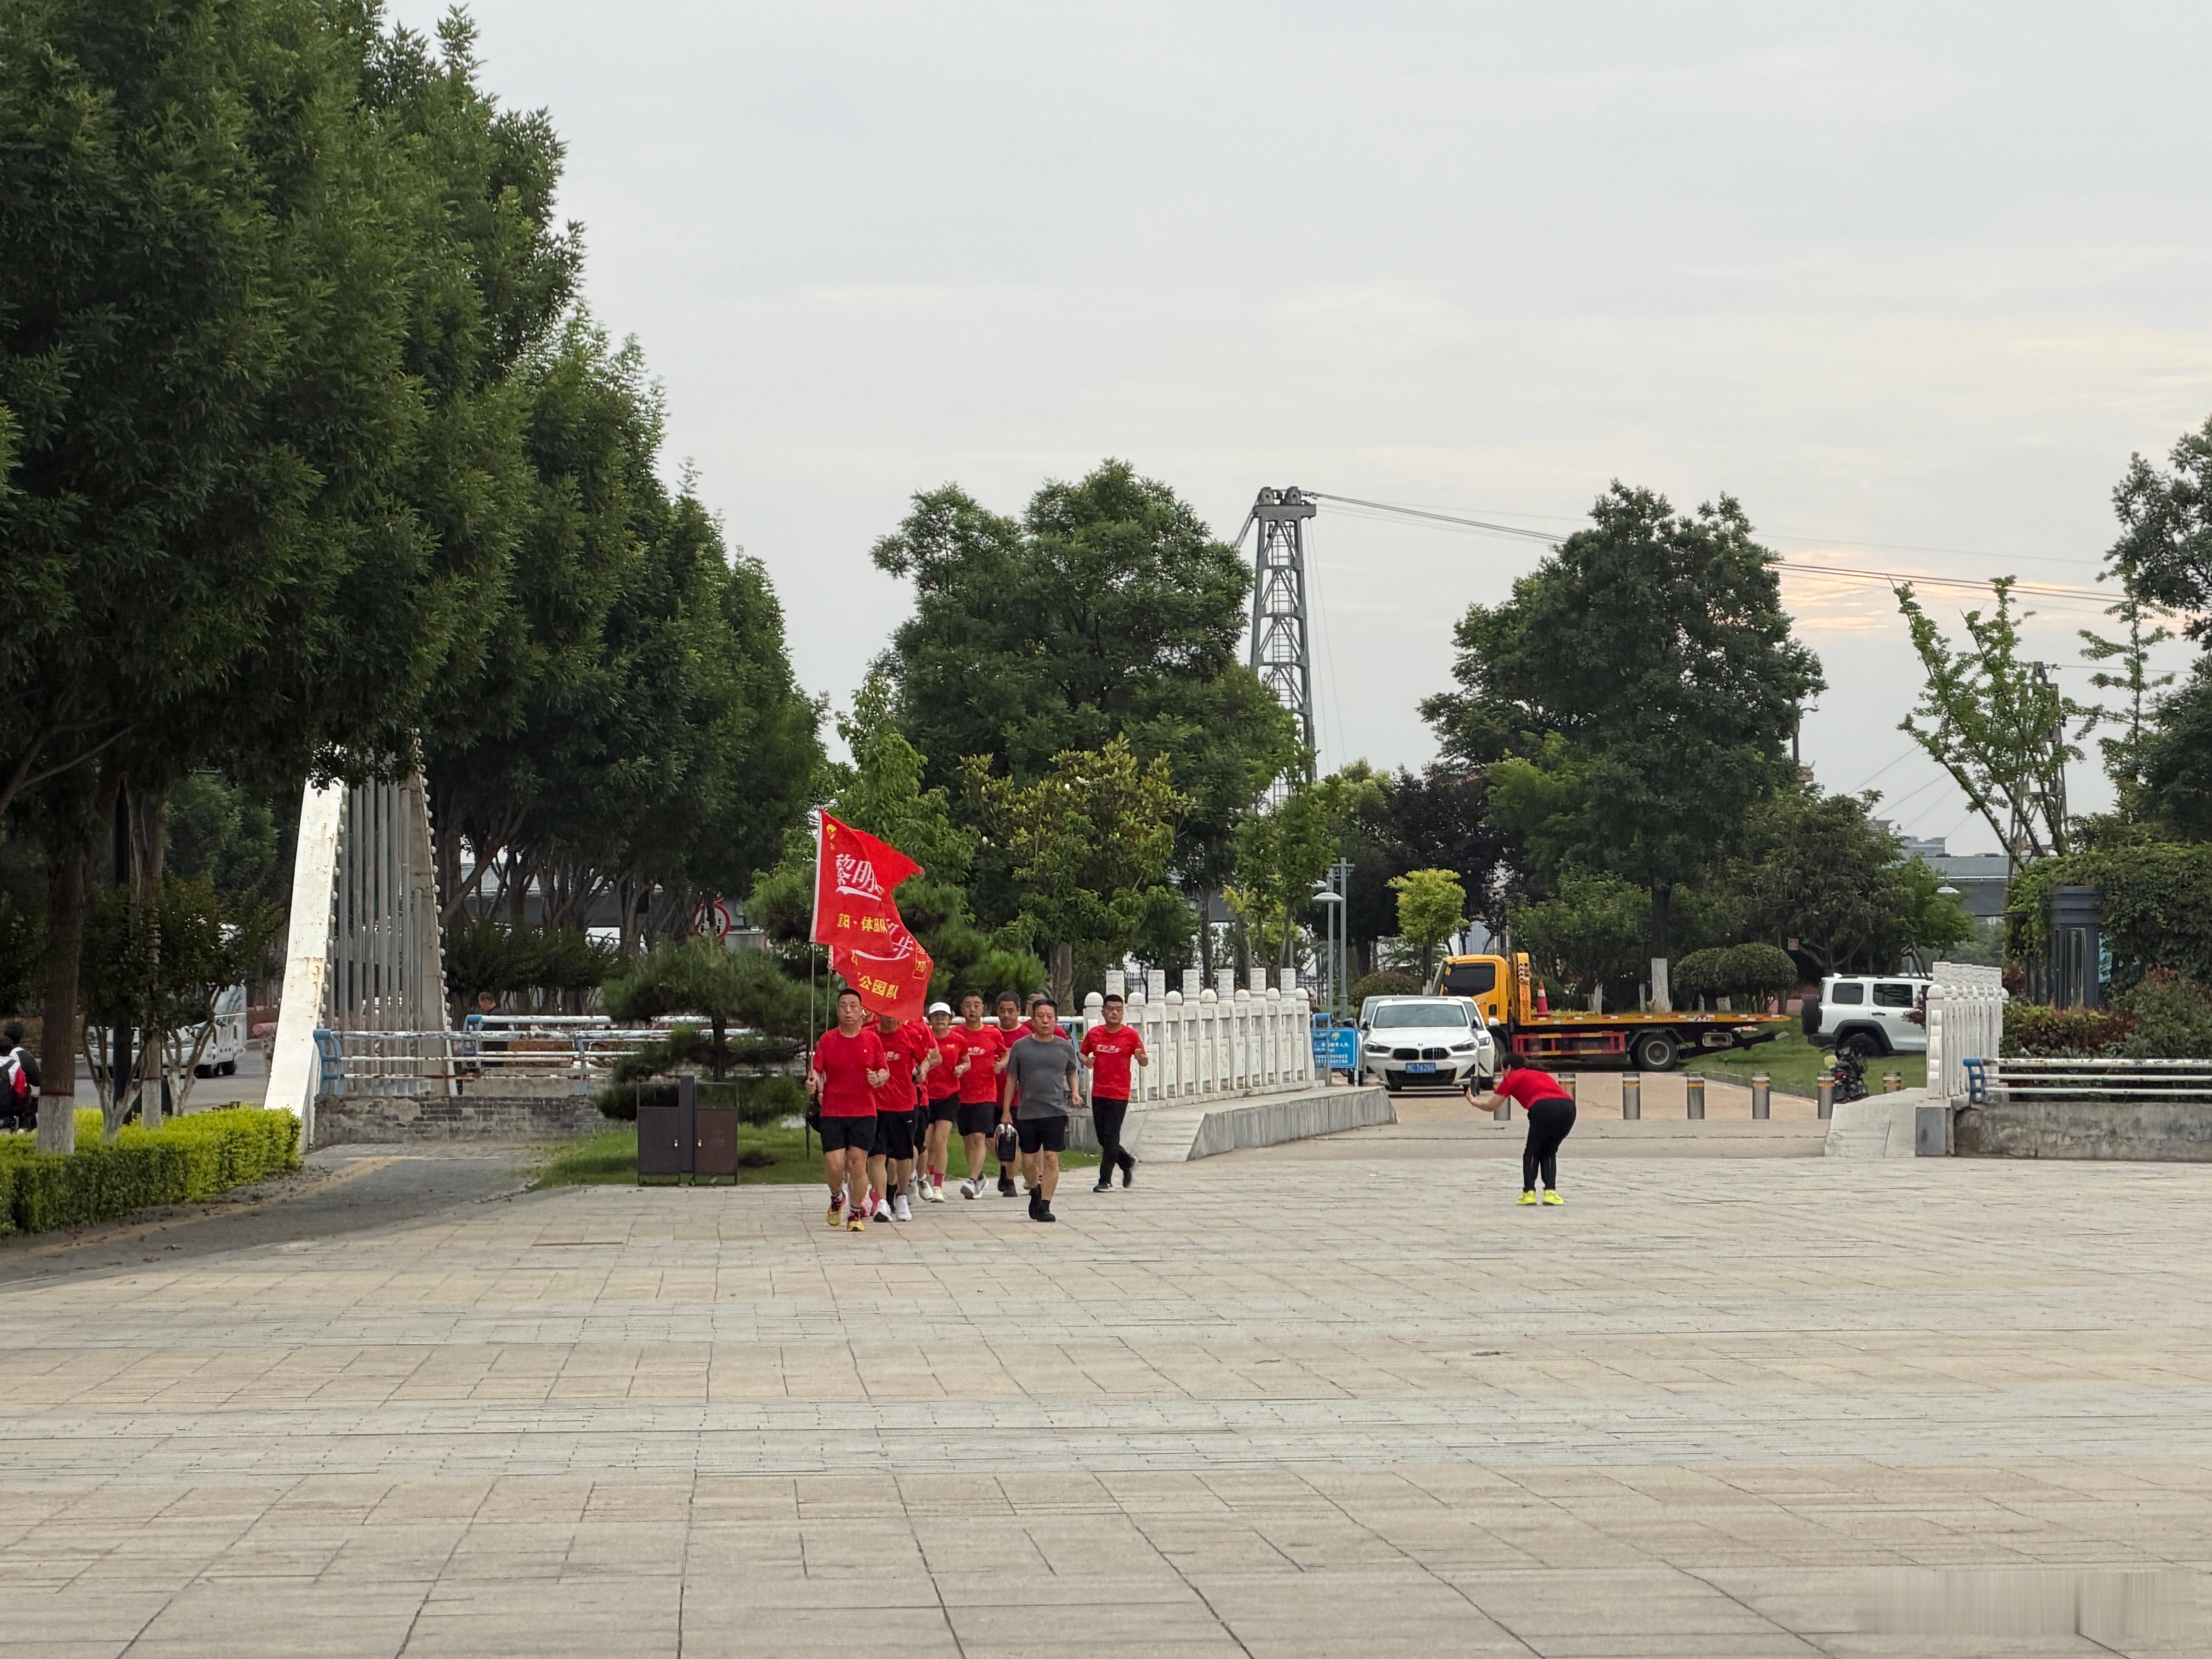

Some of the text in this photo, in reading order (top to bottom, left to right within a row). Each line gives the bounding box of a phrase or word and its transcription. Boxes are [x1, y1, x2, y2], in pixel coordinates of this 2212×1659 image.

[836, 854, 878, 892] 黎明
[859, 975, 899, 1000] 公园队
